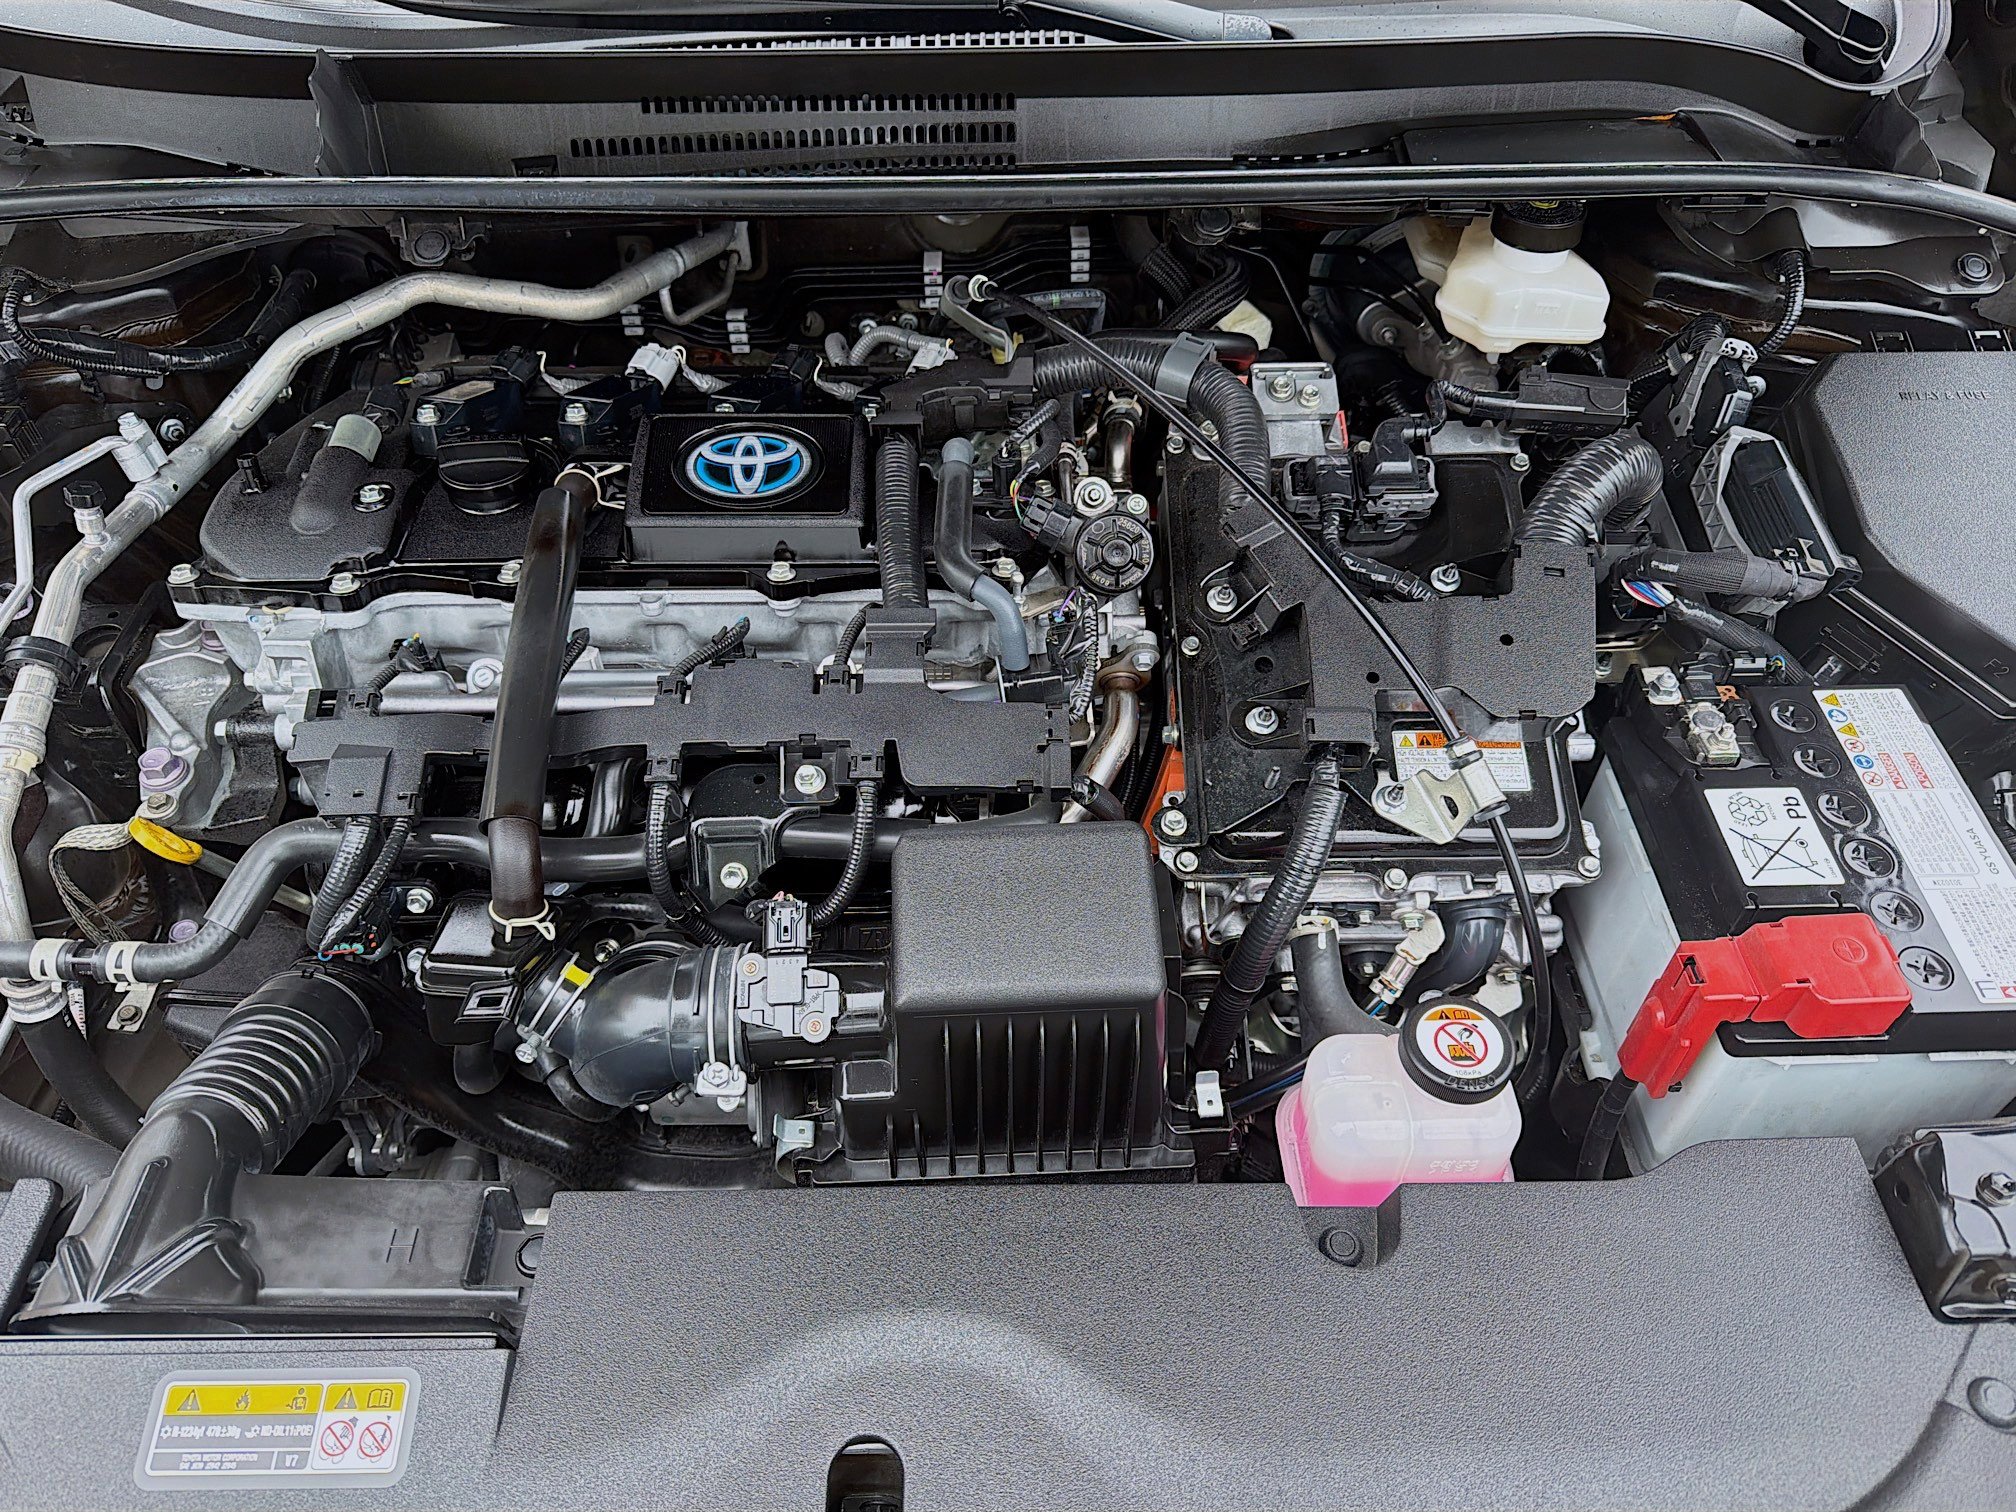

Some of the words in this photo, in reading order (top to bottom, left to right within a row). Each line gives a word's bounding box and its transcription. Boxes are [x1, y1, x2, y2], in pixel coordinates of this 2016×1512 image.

[1899, 391, 1939, 400] RELAY
[1945, 391, 1954, 400] &
[1956, 391, 1991, 400] FUSE
[1118, 517, 1140, 534] 25620
[1141, 540, 1150, 563] 37140
[1984, 658, 2010, 678] F2
[1843, 692, 1865, 714] GASES
[1867, 692, 1887, 709] BURNS
[1856, 716, 1887, 751] EXPLOSIVE
[1877, 753, 1903, 781] DANGER
[1903, 753, 1929, 780] POISON
[1783, 796, 1807, 819] Pb
[1963, 827, 1994, 860] YUASA
[1983, 861, 2002, 874] GS
[1444, 1075, 1496, 1091] DENSO
